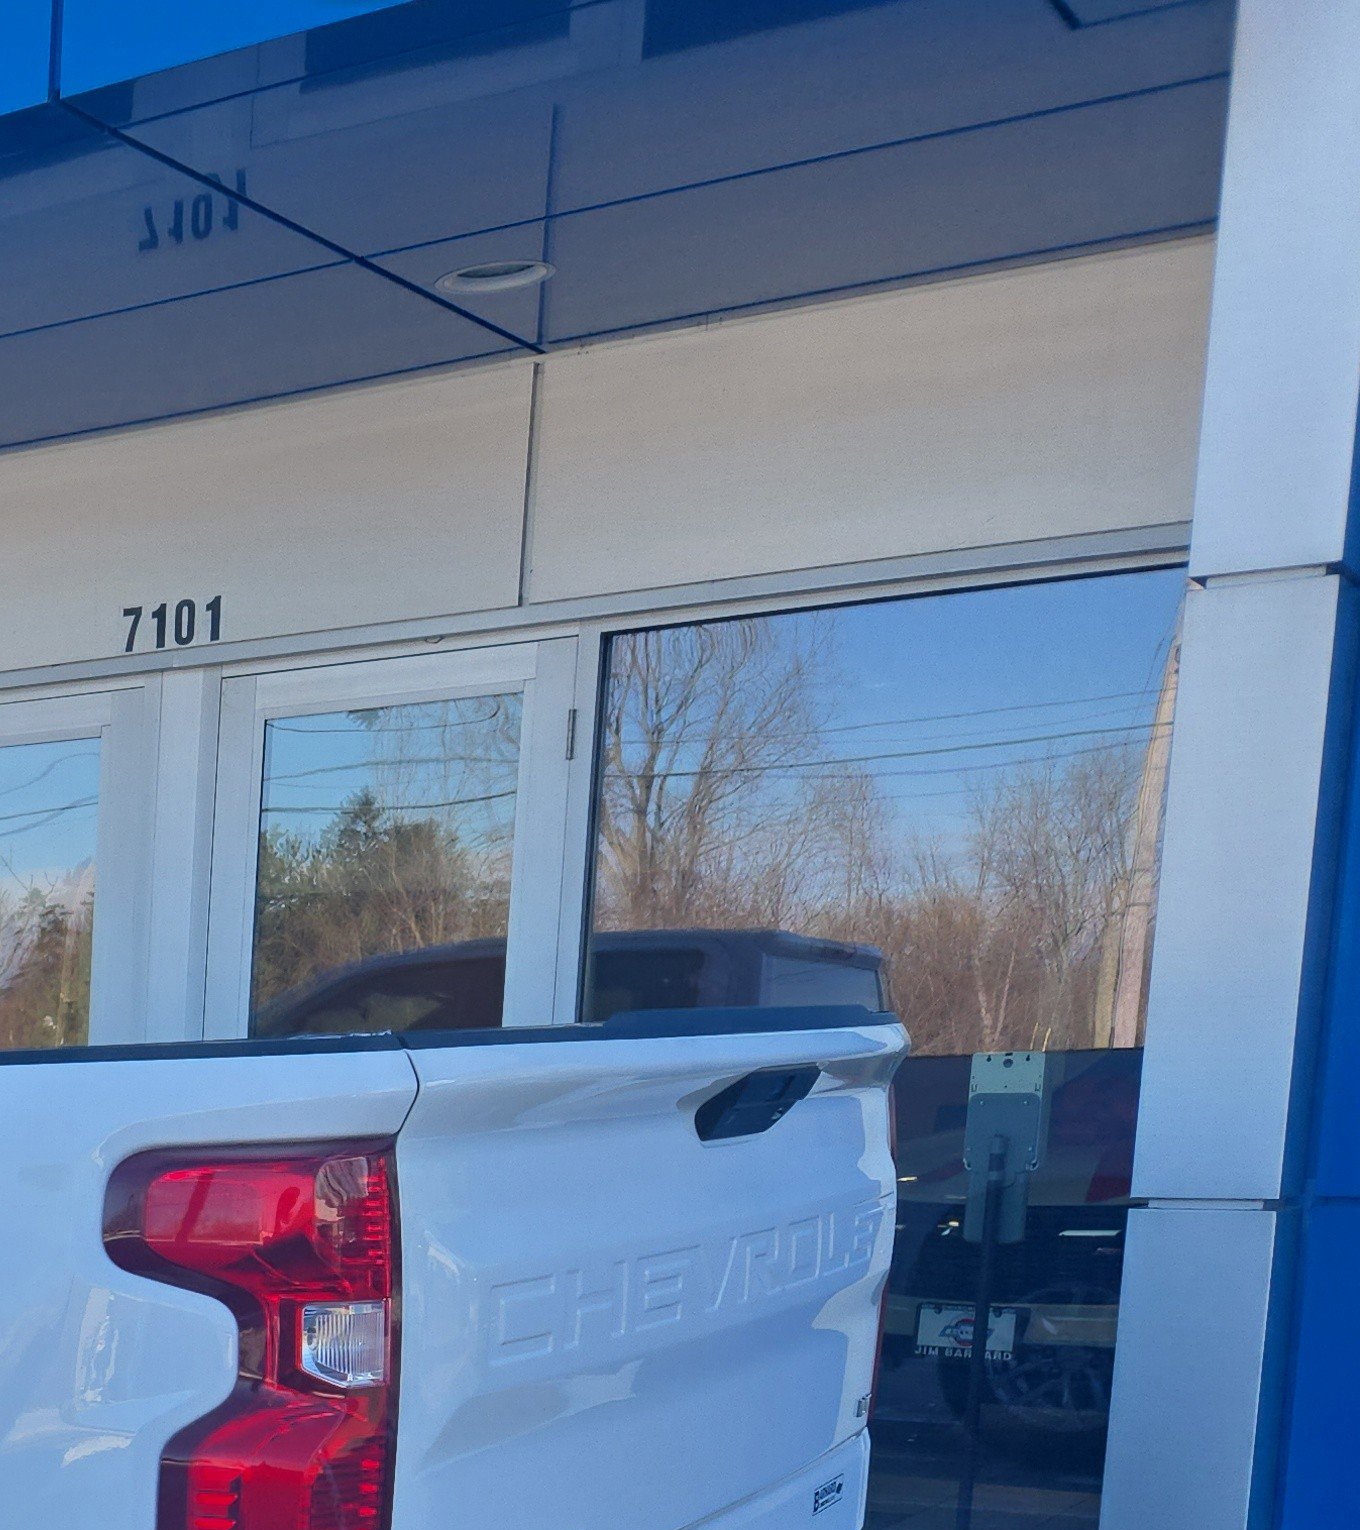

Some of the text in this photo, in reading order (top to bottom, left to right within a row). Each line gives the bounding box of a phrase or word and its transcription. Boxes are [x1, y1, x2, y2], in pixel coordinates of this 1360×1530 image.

[122, 595, 222, 653] 7101
[915, 1346, 1013, 1361] JIM BARARD
